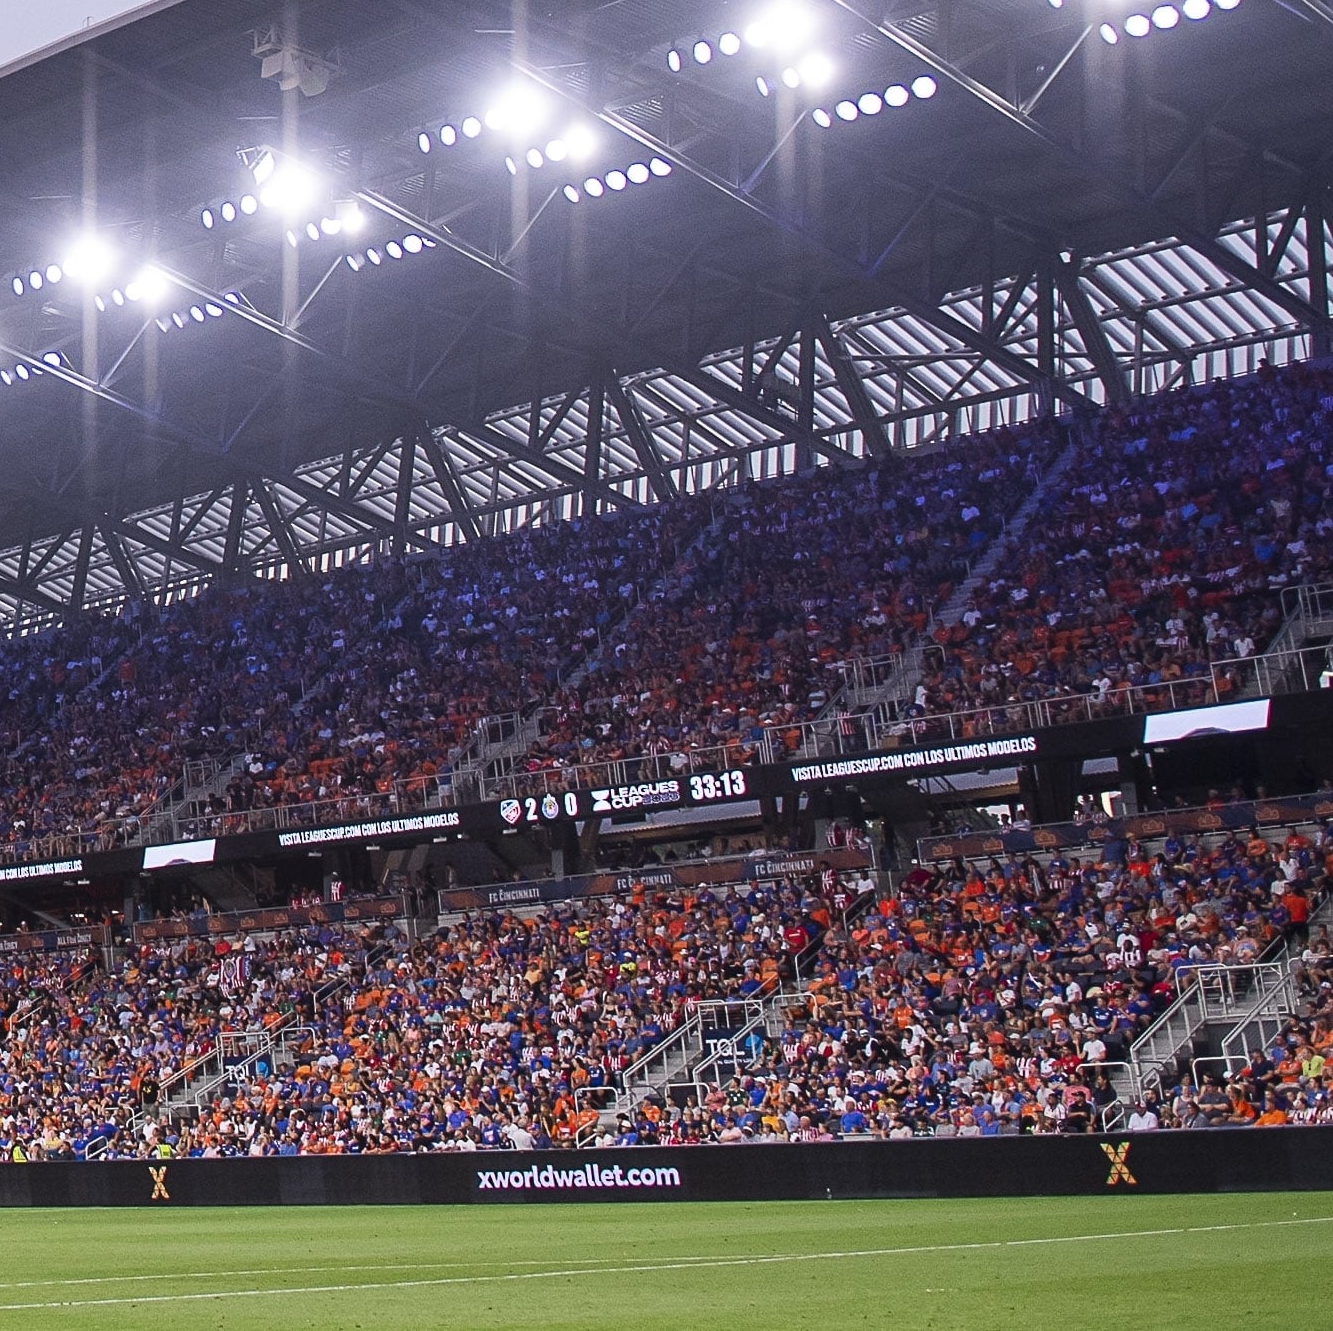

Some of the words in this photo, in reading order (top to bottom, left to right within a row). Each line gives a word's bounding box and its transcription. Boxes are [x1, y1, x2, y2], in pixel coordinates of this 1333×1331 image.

[792, 766, 821, 782] VISITA
[821, 755, 904, 780] LEAGUESCUP.COM
[904, 752, 924, 768] CON
[924, 749, 944, 765] LOS
[988, 737, 1036, 757] MODELOS
[610, 781, 679, 799] LEAGUES
[690, 770, 745, 801] 33:13
[525, 798, 537, 821] 2
[564, 792, 578, 817] 0
[612, 794, 643, 809] CUP
[361, 823, 378, 837] CON
[628, 874, 672, 888] CCINNATI
[477, 1164, 680, 1189] xworldwallet.com
